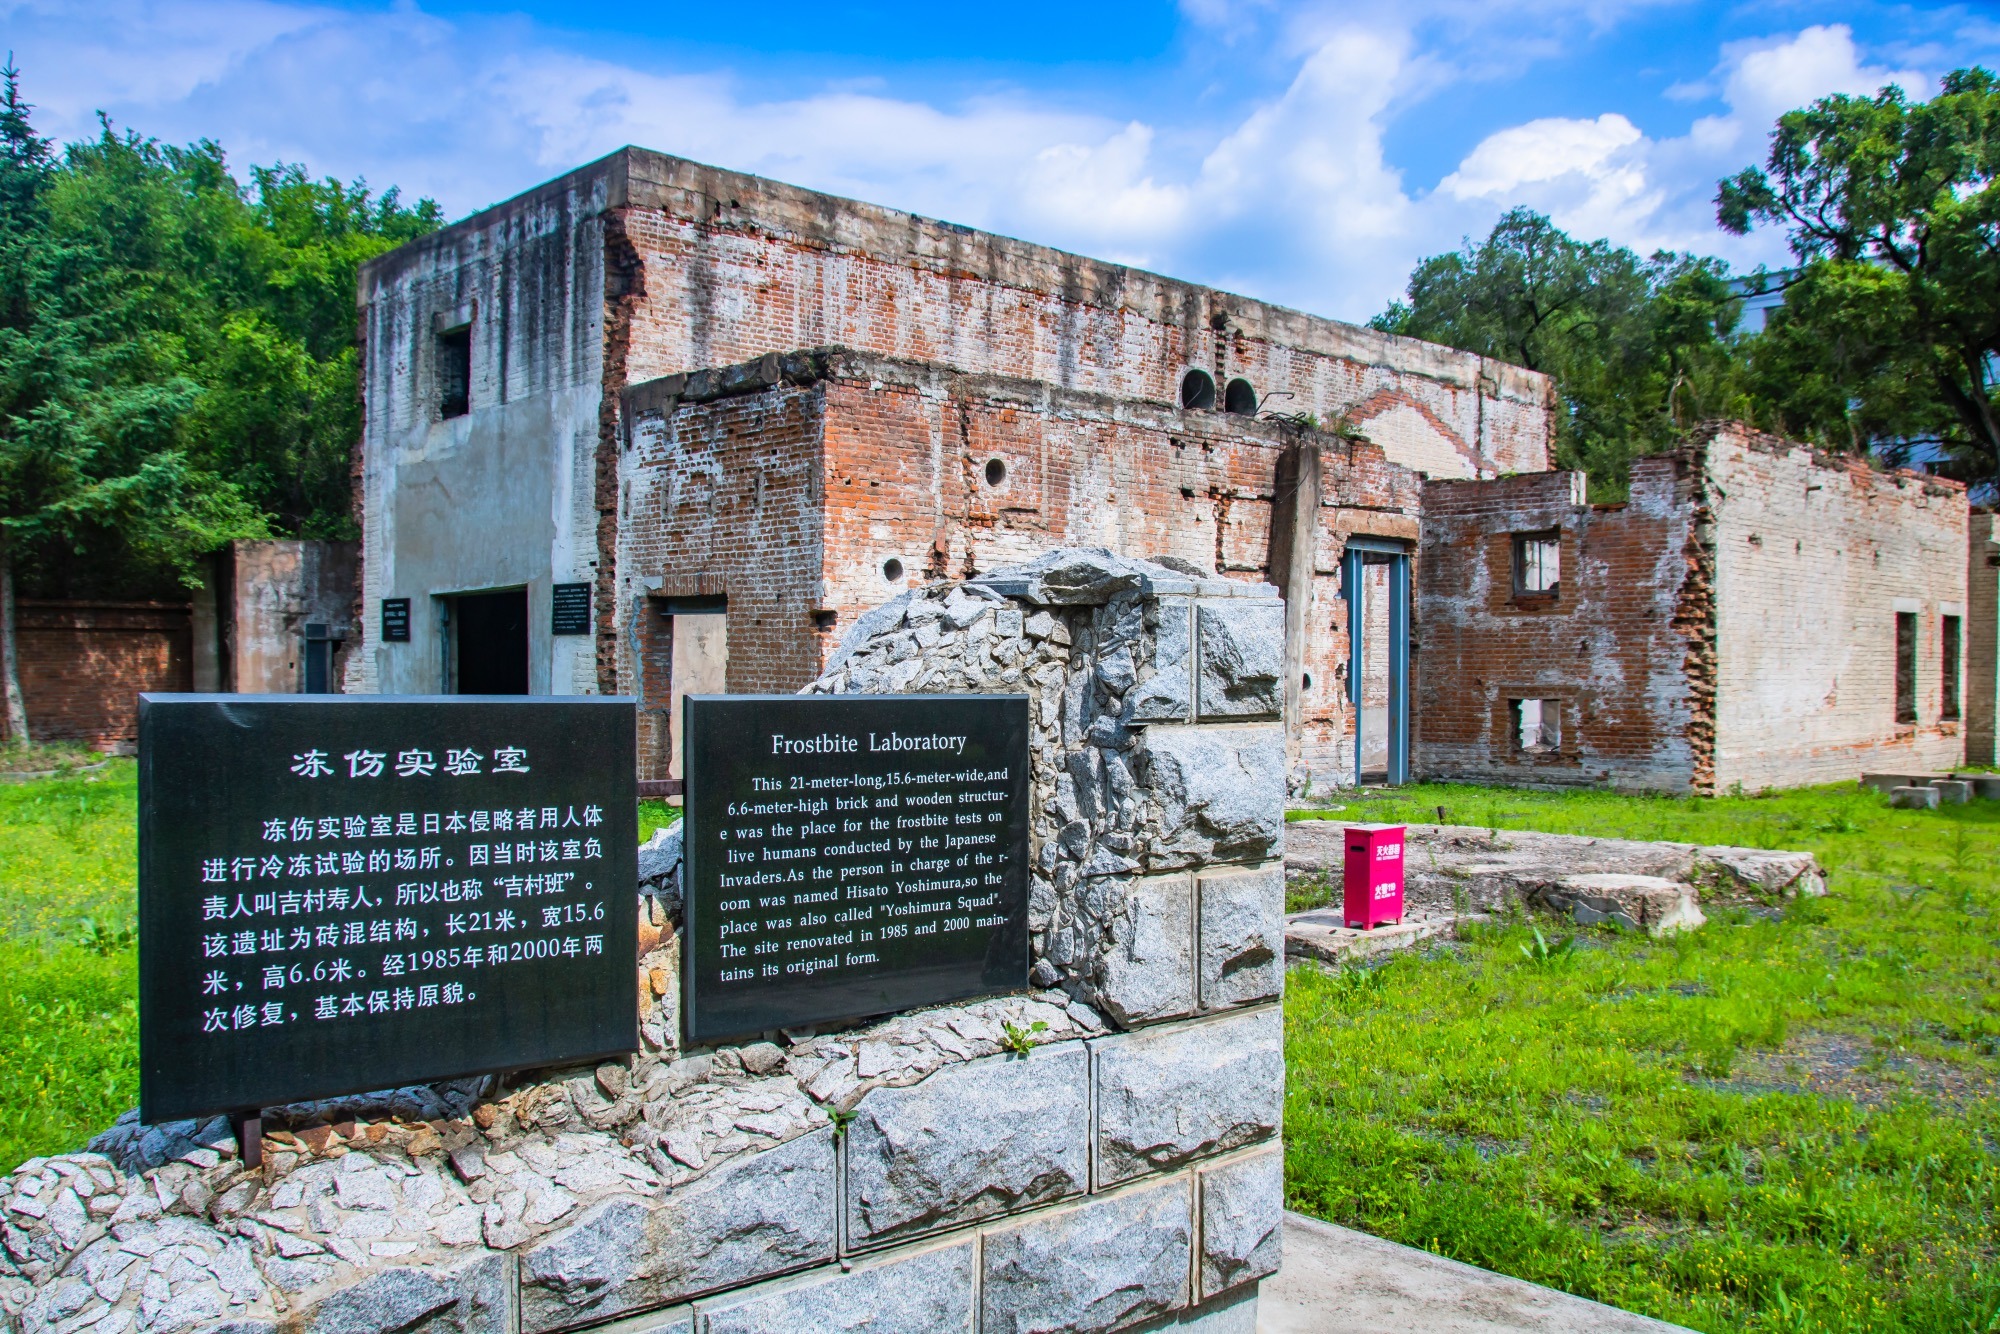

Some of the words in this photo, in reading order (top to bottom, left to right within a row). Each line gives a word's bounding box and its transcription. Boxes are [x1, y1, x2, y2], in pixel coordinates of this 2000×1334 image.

[772, 733, 858, 754] Frostbite
[869, 732, 966, 755] Laboratory
[291, 746, 530, 778] 冻伤实验室
[752, 777, 782, 791] This
[790, 768, 1008, 790] 21-meter-long,15.6-meter-wide,and
[728, 798, 828, 815] 6.6-meter-high
[836, 796, 868, 810] brick
[875, 794, 898, 807] and
[906, 792, 952, 805] wooden
[959, 791, 1008, 803] structur-
[262, 804, 603, 842] 冻伤实验室是日本侵略者用人体
[720, 830, 727, 840] e
[736, 828, 763, 839] was
[772, 823, 793, 836] the
[801, 821, 836, 839] place
[844, 819, 862, 832] for
[870, 817, 889, 830] the
[897, 814, 948, 828] frostbite
[955, 813, 981, 824] tests
[988, 813, 1002, 822] on
[202, 837, 602, 882] 进行冷冻试验的场所。因当时该室负
[728, 850, 754, 863] live
[763, 847, 816, 860] humans
[824, 839, 890, 856] conducted
[898, 838, 912, 854] by
[920, 836, 938, 848] the
[945, 834, 996, 849] Japanese
[720, 869, 804, 887] Invaders.As
[812, 866, 833, 879] the
[841, 865, 883, 881] person
[891, 861, 903, 872] in
[910, 858, 950, 872] charge
[957, 854, 968, 866] of
[975, 853, 992, 865] the
[999, 854, 1008, 862] r-
[720, 899, 750, 911] oom
[759, 896, 785, 907] was
[794, 887, 838, 904] named
[847, 885, 888, 899] Hisato
[896, 878, 977, 893] Yoshimura,so
[985, 873, 1002, 885] the
[720, 920, 757, 939] place
[766, 918, 792, 929] was
[800, 912, 826, 926] also
[834, 906, 872, 922] called
[720, 944, 746, 958] The
[755, 941, 779, 954] site
[787, 930, 853, 950] renovated
[861, 929, 873, 941] in
[880, 924, 907, 939] 1985
[915, 921, 936, 935] and
[944, 917, 969, 931] 2000
[976, 914, 1008, 927] main-
[720, 967, 754, 981] tains
[762, 964, 779, 976] its
[787, 954, 838, 975] original
[846, 953, 879, 965] form.
